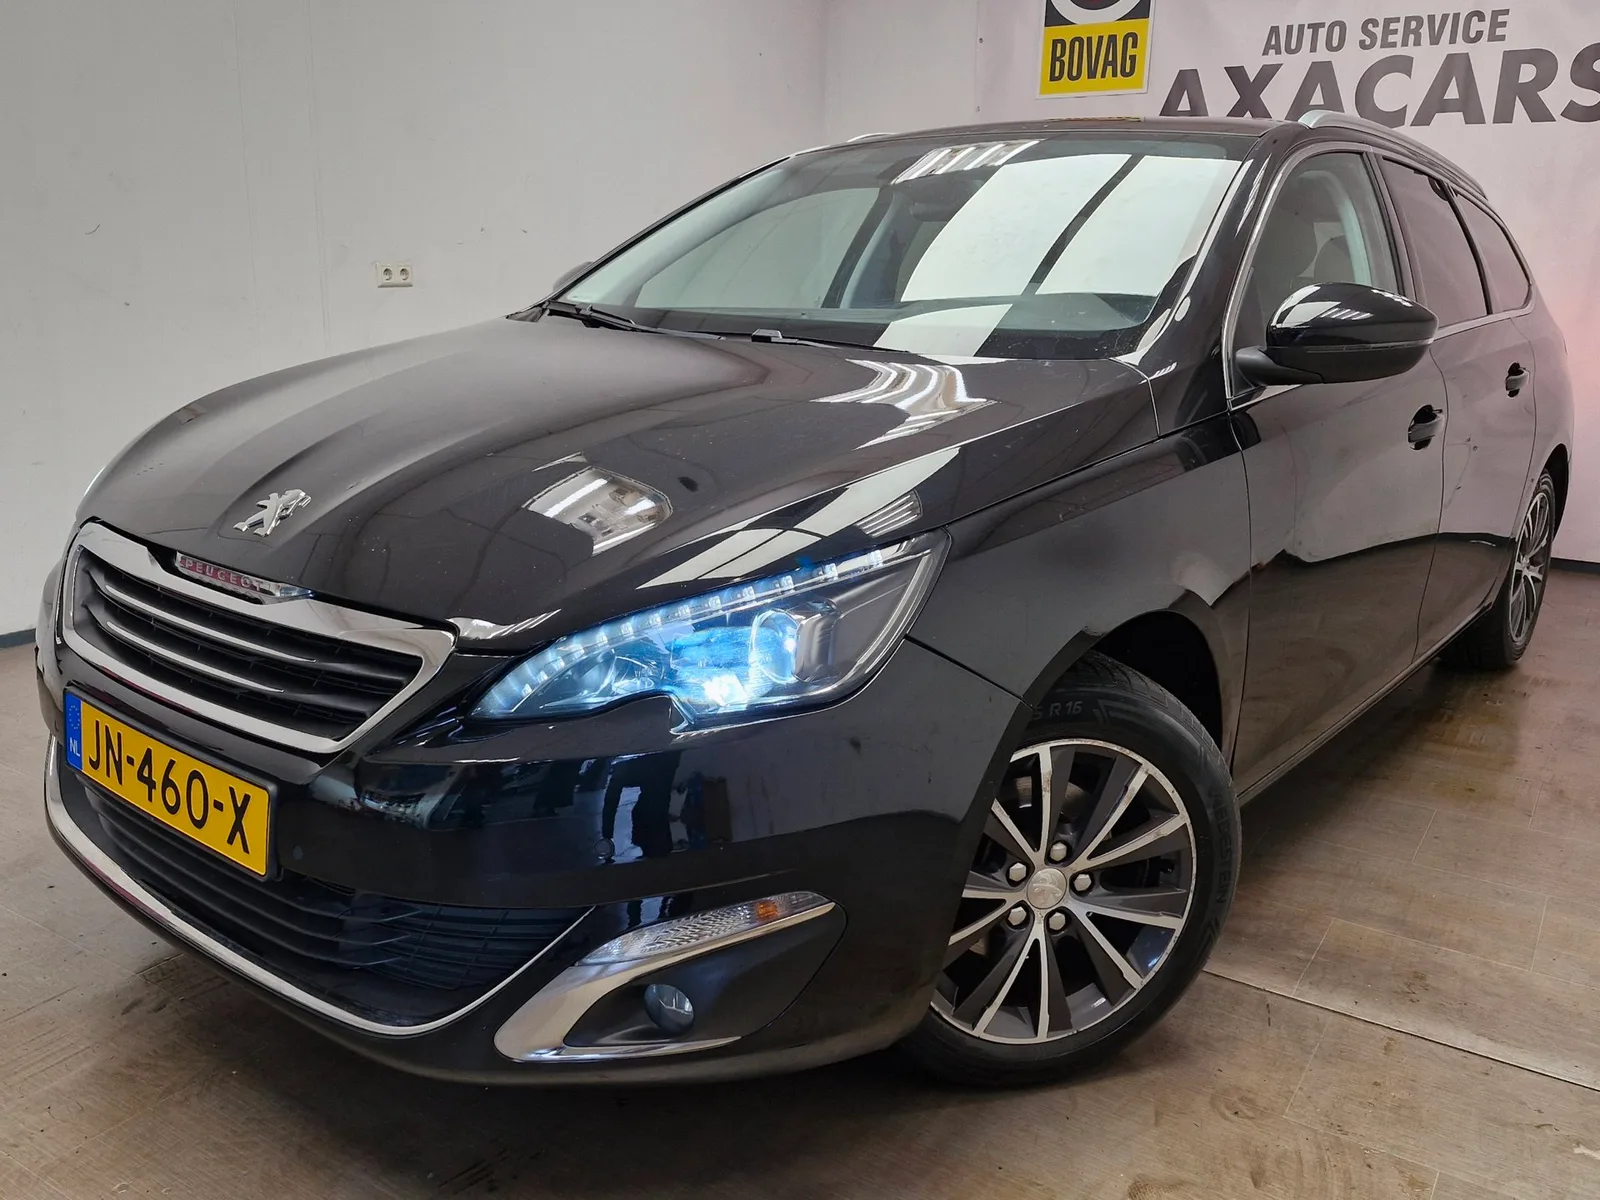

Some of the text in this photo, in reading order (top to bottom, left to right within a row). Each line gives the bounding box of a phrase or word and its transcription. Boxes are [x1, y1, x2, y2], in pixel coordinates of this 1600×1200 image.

[1262, 9, 1510, 56] AUTO SERVICE
[1049, 32, 1139, 82] BOVAG
[1159, 43, 1600, 129] AXACARS
[185, 560, 264, 592] PEUGEOT
[1065, 701, 1083, 715] 16
[69, 737, 81, 757] NL
[89, 719, 252, 855] JN-460-X
